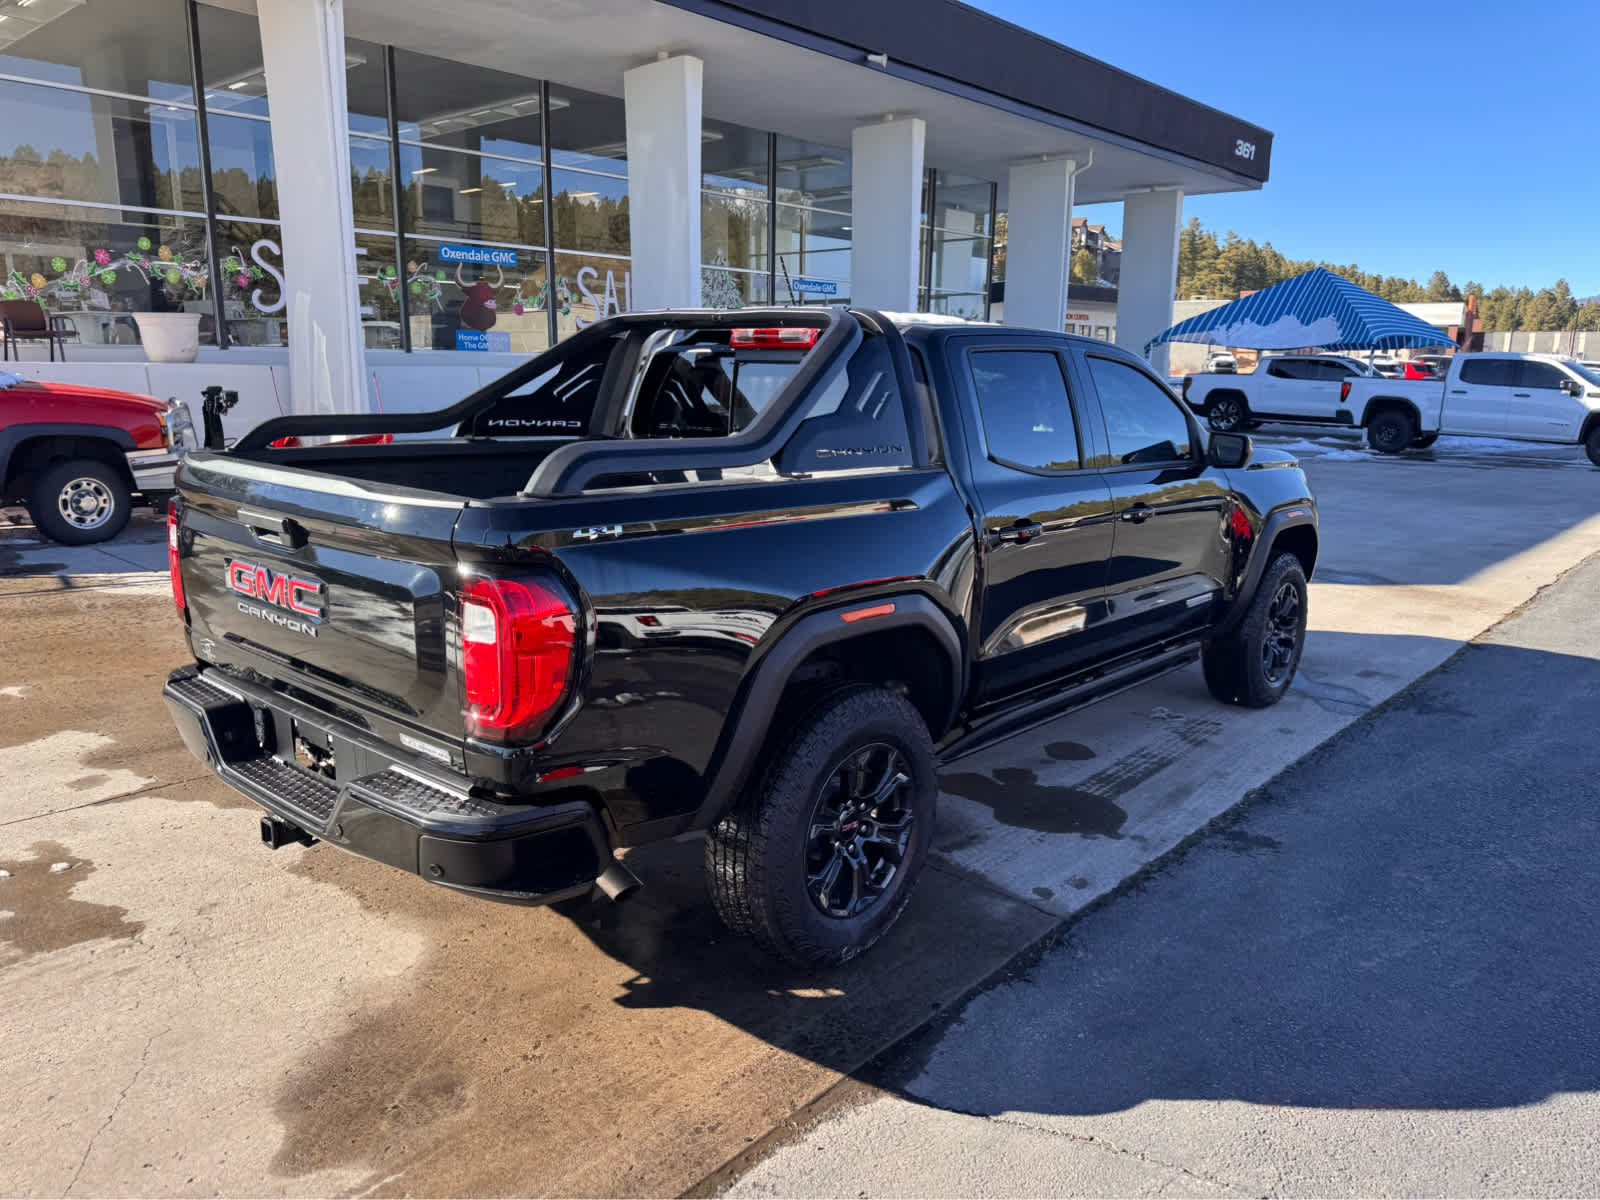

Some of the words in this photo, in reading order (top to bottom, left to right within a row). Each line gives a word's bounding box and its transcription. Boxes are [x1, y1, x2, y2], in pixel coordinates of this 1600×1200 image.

[1234, 139, 1256, 161] 361
[441, 247, 490, 262] Oxendale
[491, 251, 516, 263] GMC
[228, 560, 321, 618] GMC
[237, 601, 319, 637] CANYON
